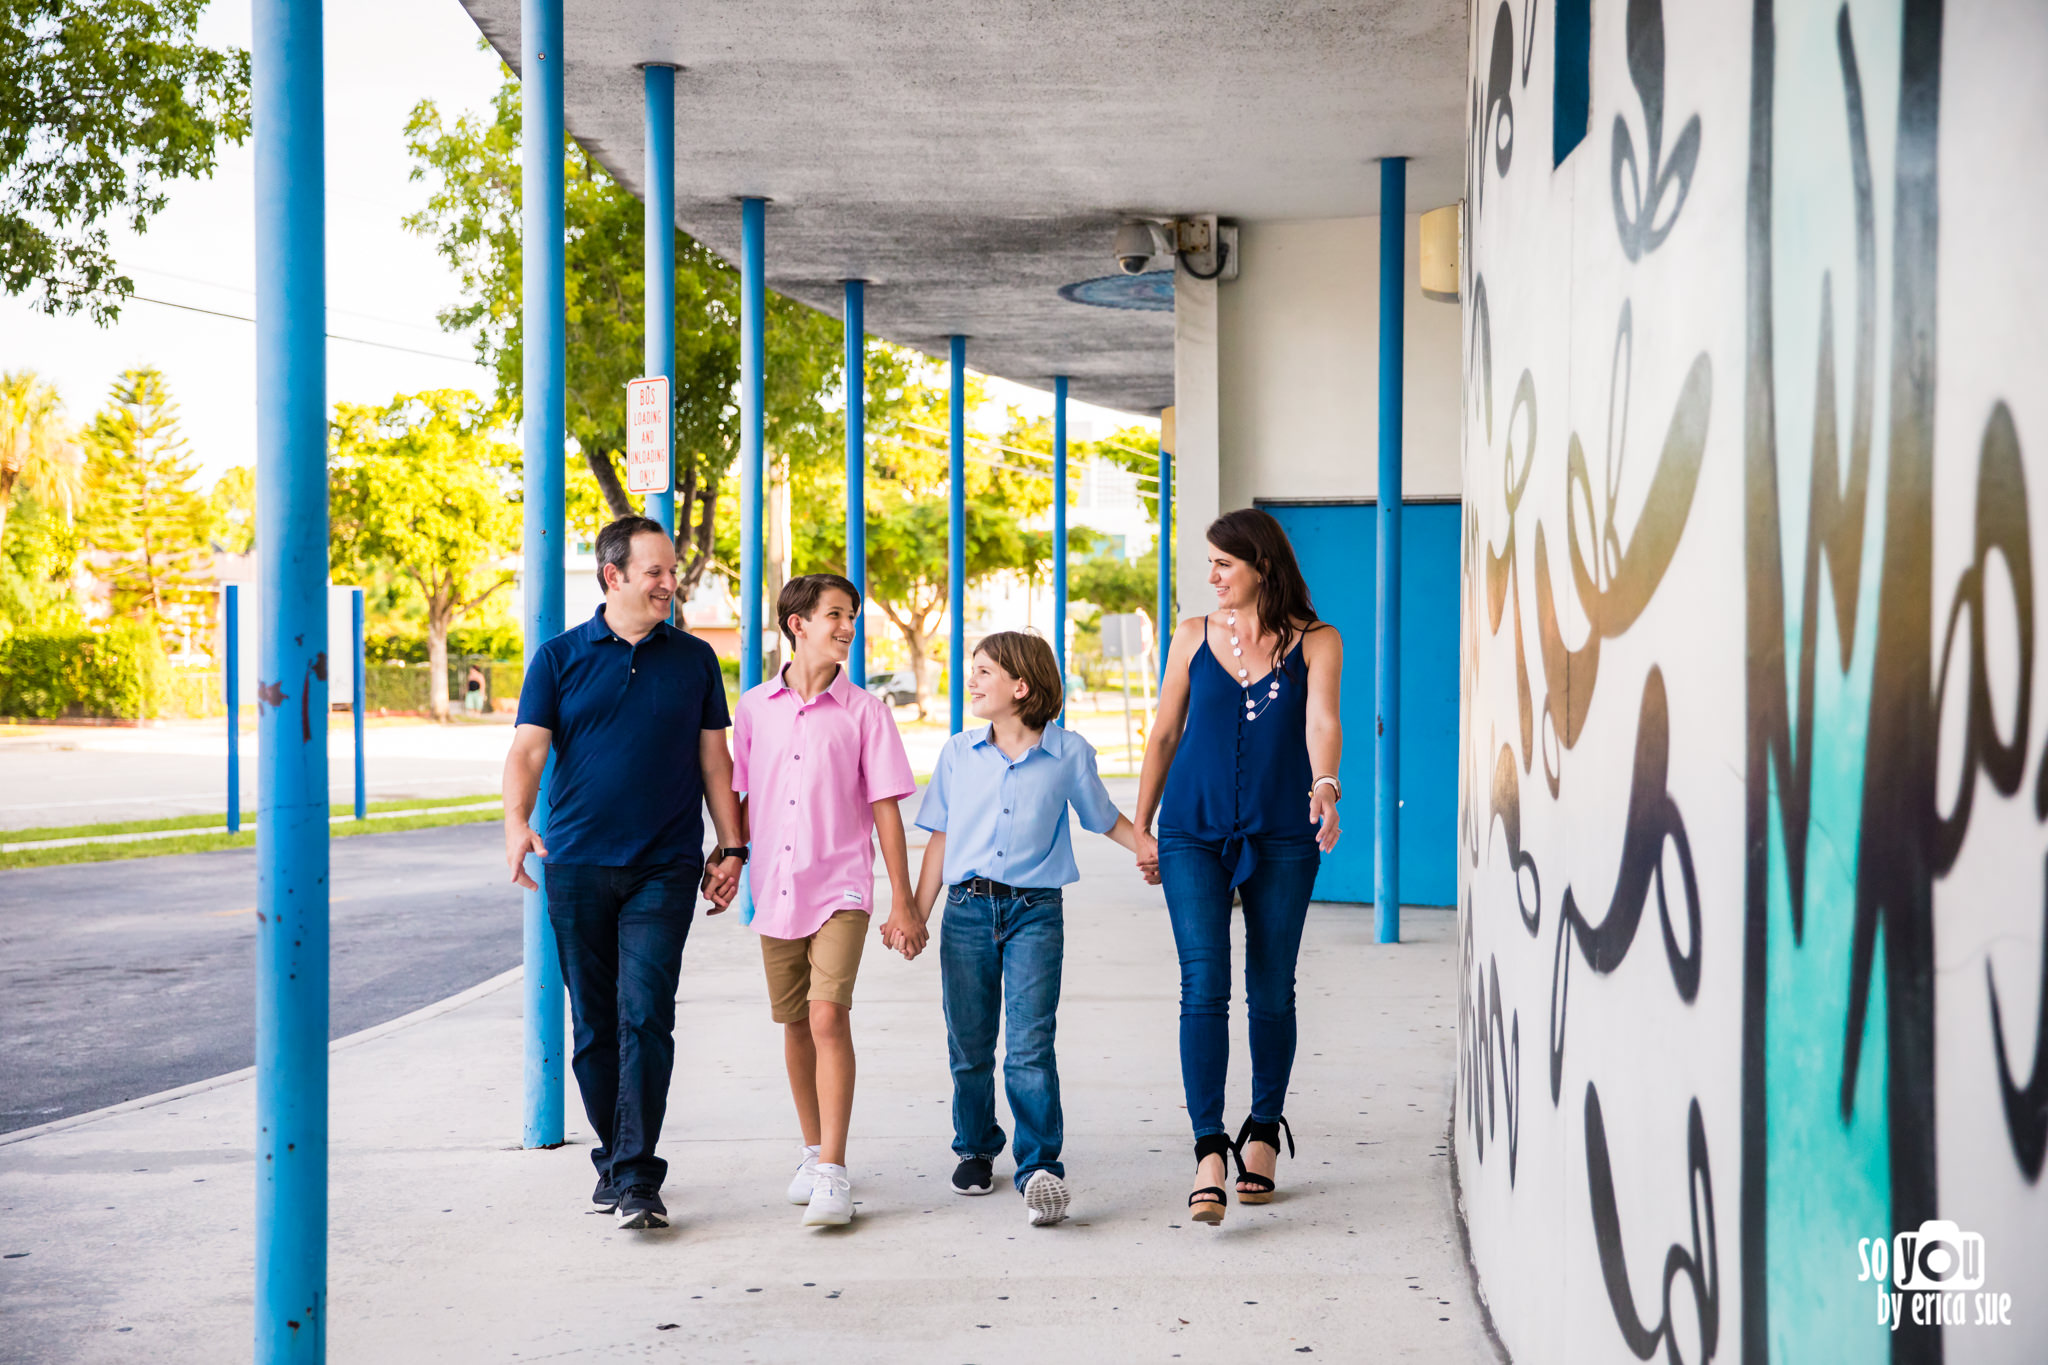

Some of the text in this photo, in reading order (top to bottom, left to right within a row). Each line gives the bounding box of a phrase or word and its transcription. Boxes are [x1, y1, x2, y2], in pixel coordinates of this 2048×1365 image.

[640, 388, 655, 406] BUS
[634, 410, 662, 426] LOADING
[641, 430, 654, 444] AND
[631, 449, 665, 465] UNLOADING
[640, 470, 655, 484] ONLY
